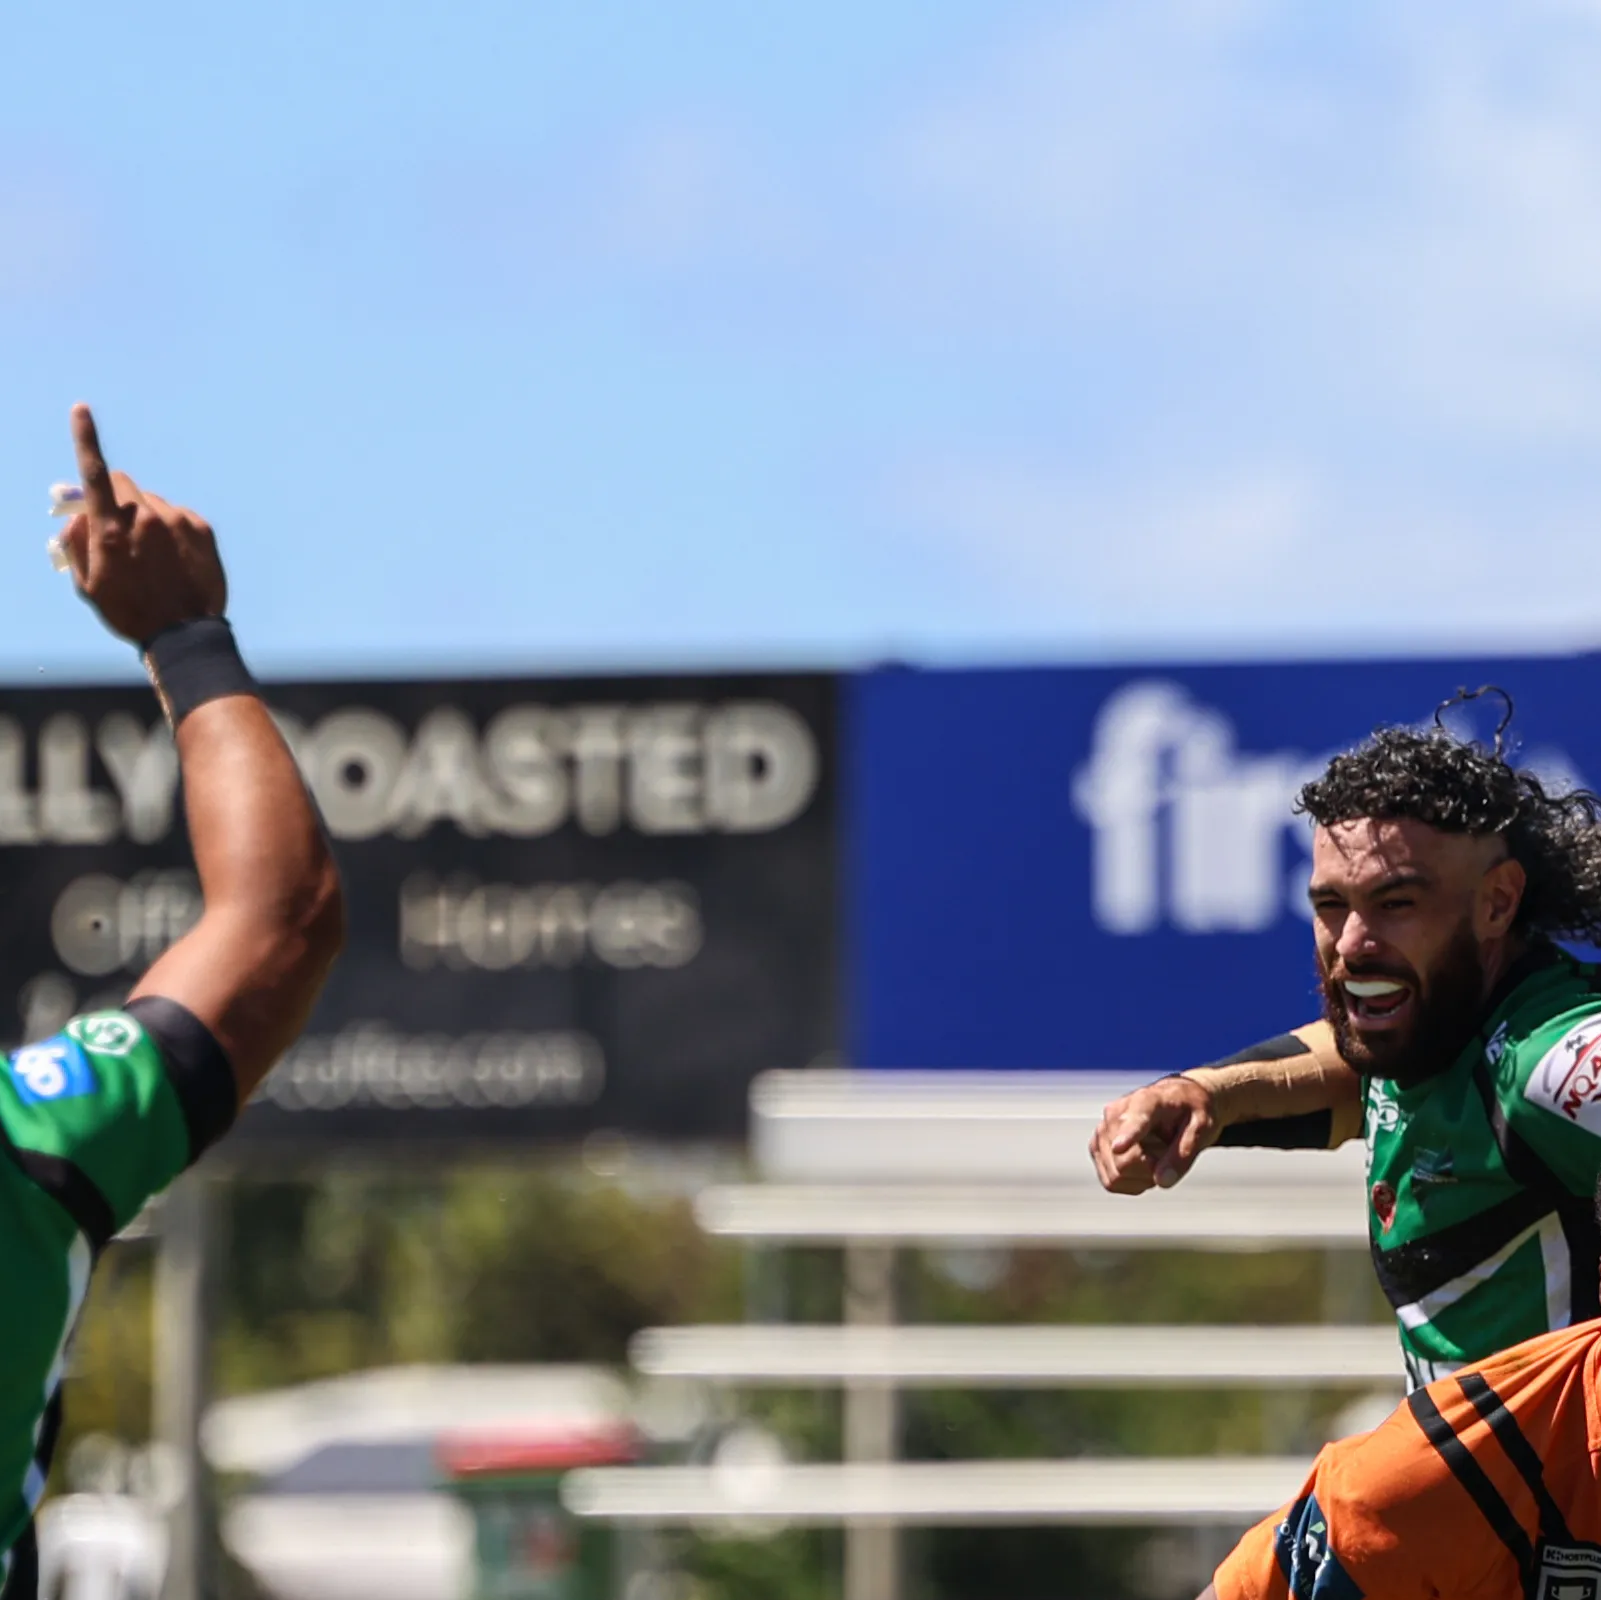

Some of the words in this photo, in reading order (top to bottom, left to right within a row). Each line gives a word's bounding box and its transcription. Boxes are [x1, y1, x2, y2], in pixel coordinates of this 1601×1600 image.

[268, 698, 818, 840] OASTED
[1074, 680, 1315, 935] fir
[1561, 1075, 1599, 1121] NQ
